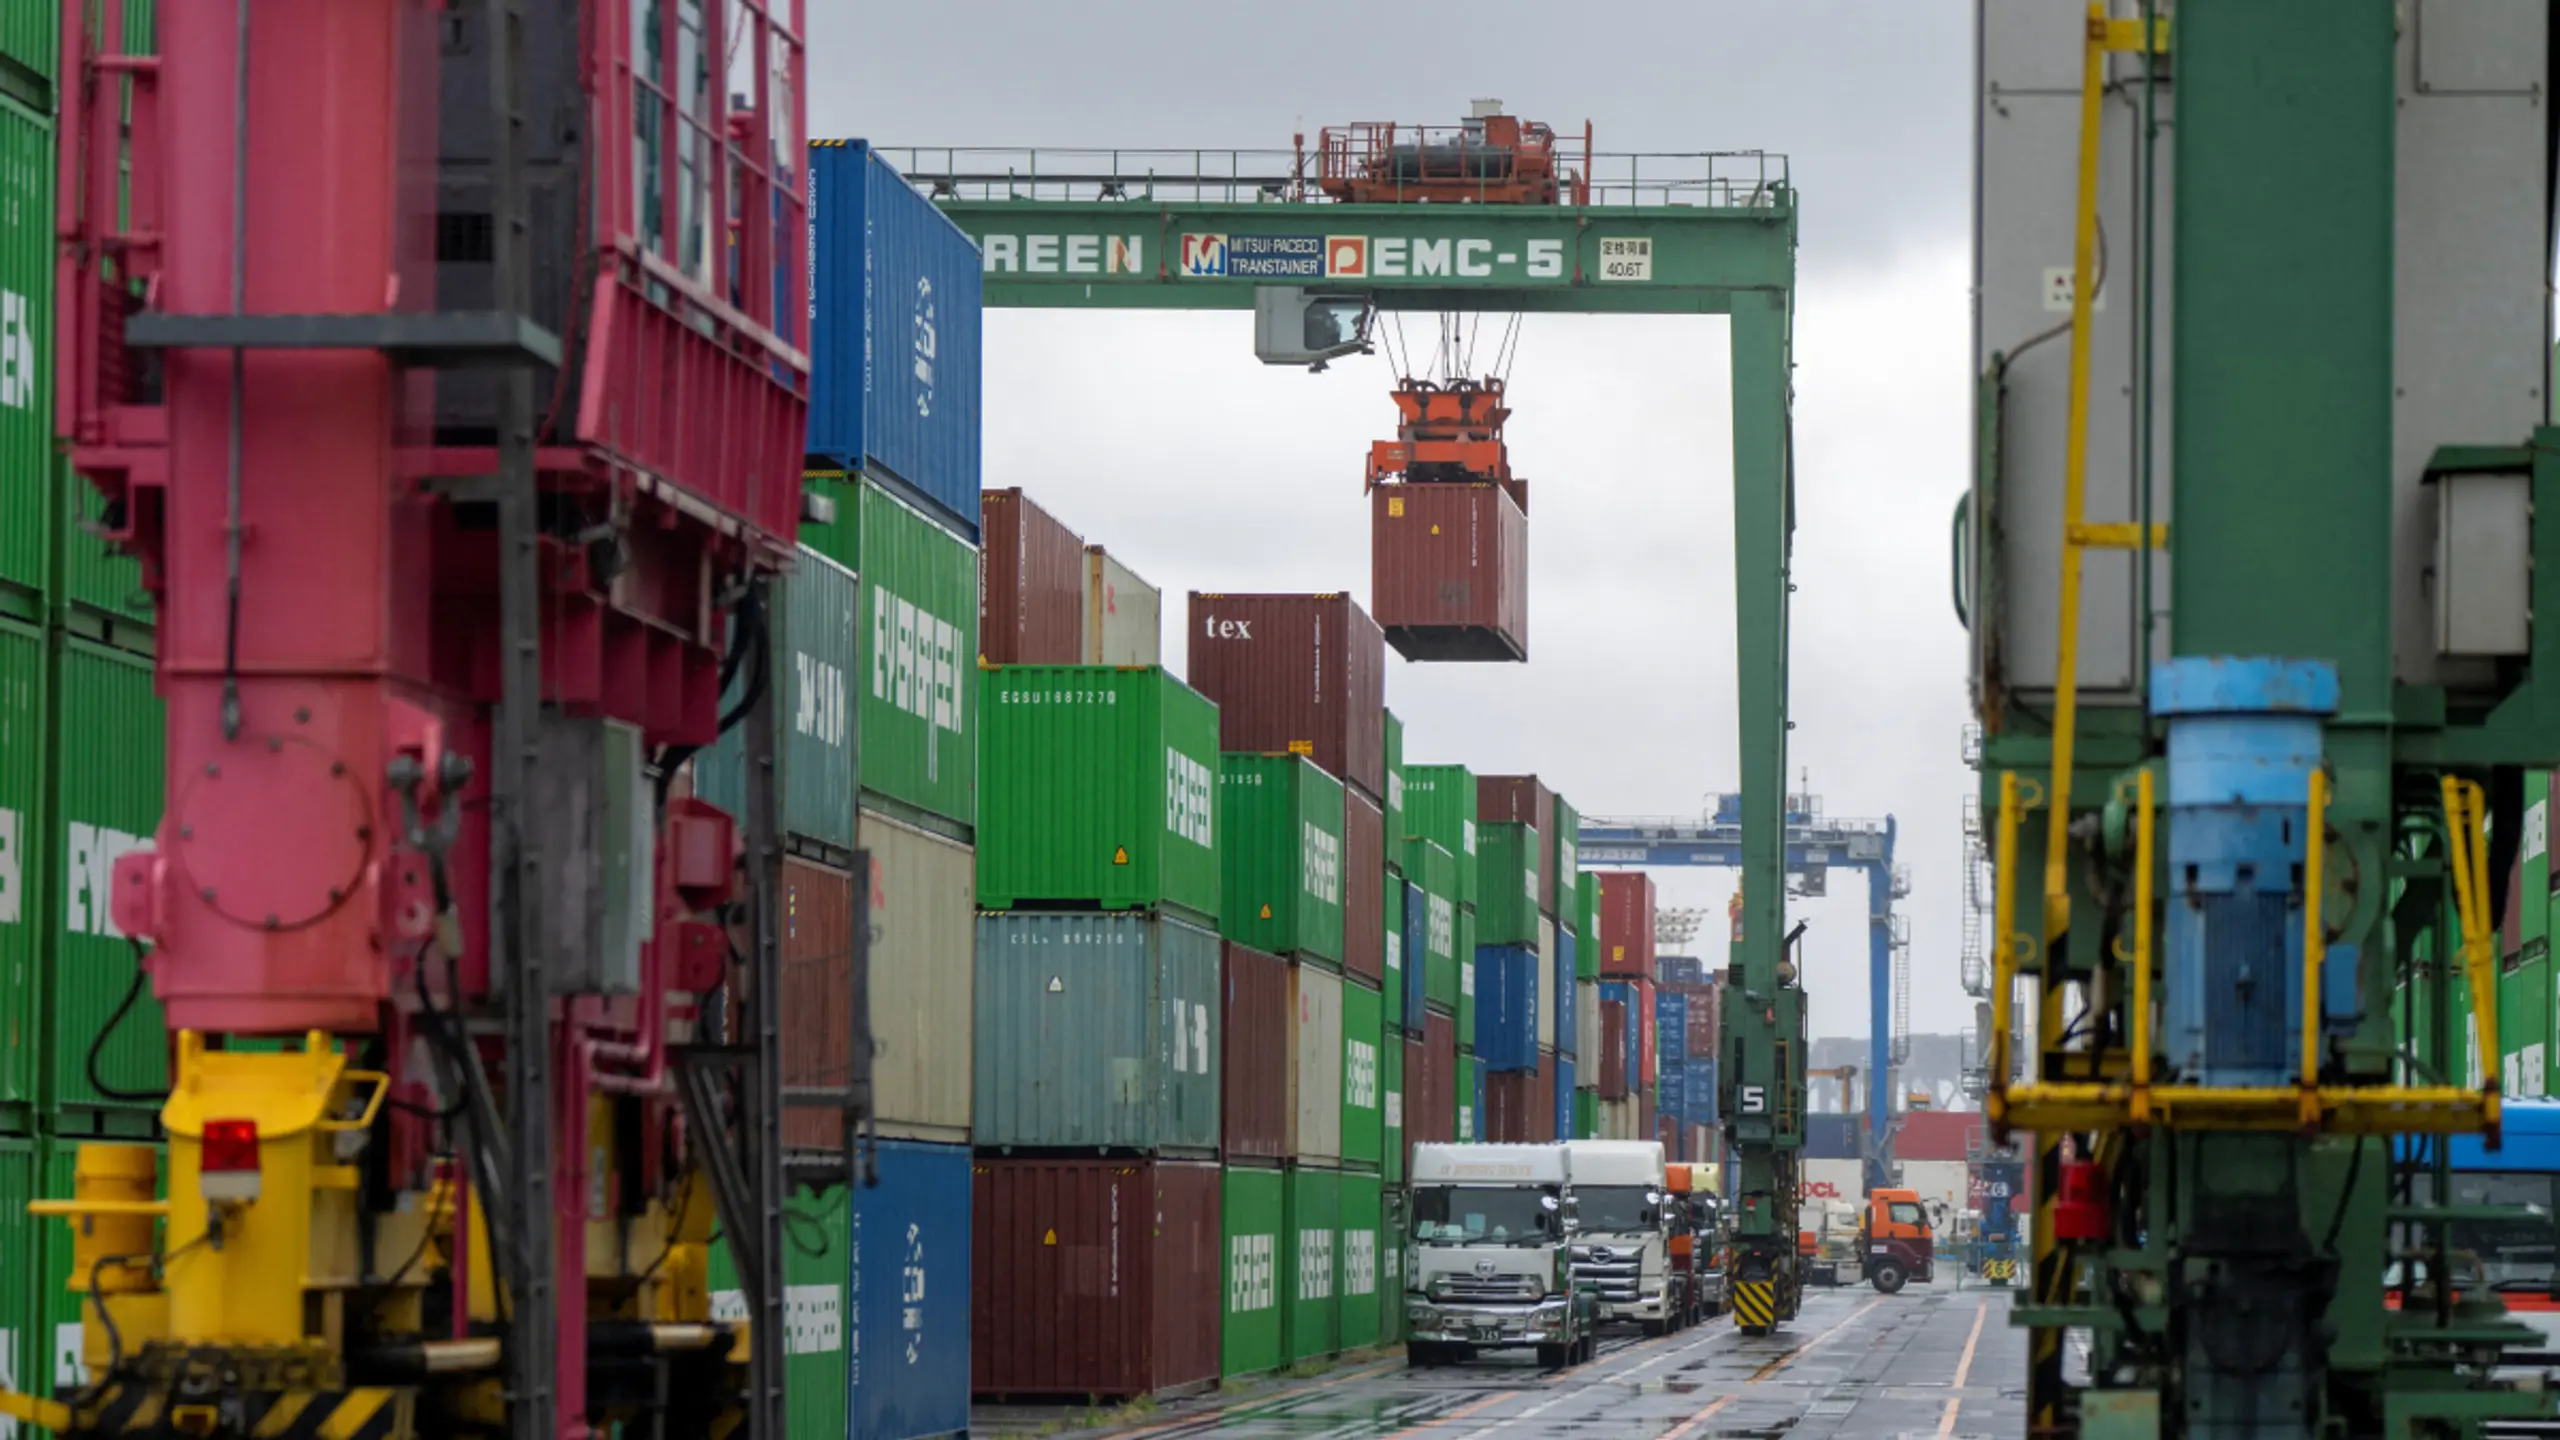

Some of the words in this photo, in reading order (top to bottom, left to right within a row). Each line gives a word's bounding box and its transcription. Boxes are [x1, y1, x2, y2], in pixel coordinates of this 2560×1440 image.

[970, 235, 1142, 272] REEN
[1231, 258, 1318, 274] TRANSTAINER
[1374, 238, 1563, 277] EMC-5
[1607, 262, 1643, 277] 40.6T
[1206, 614, 1252, 639] tex
[1743, 1086, 1764, 1112] 5
